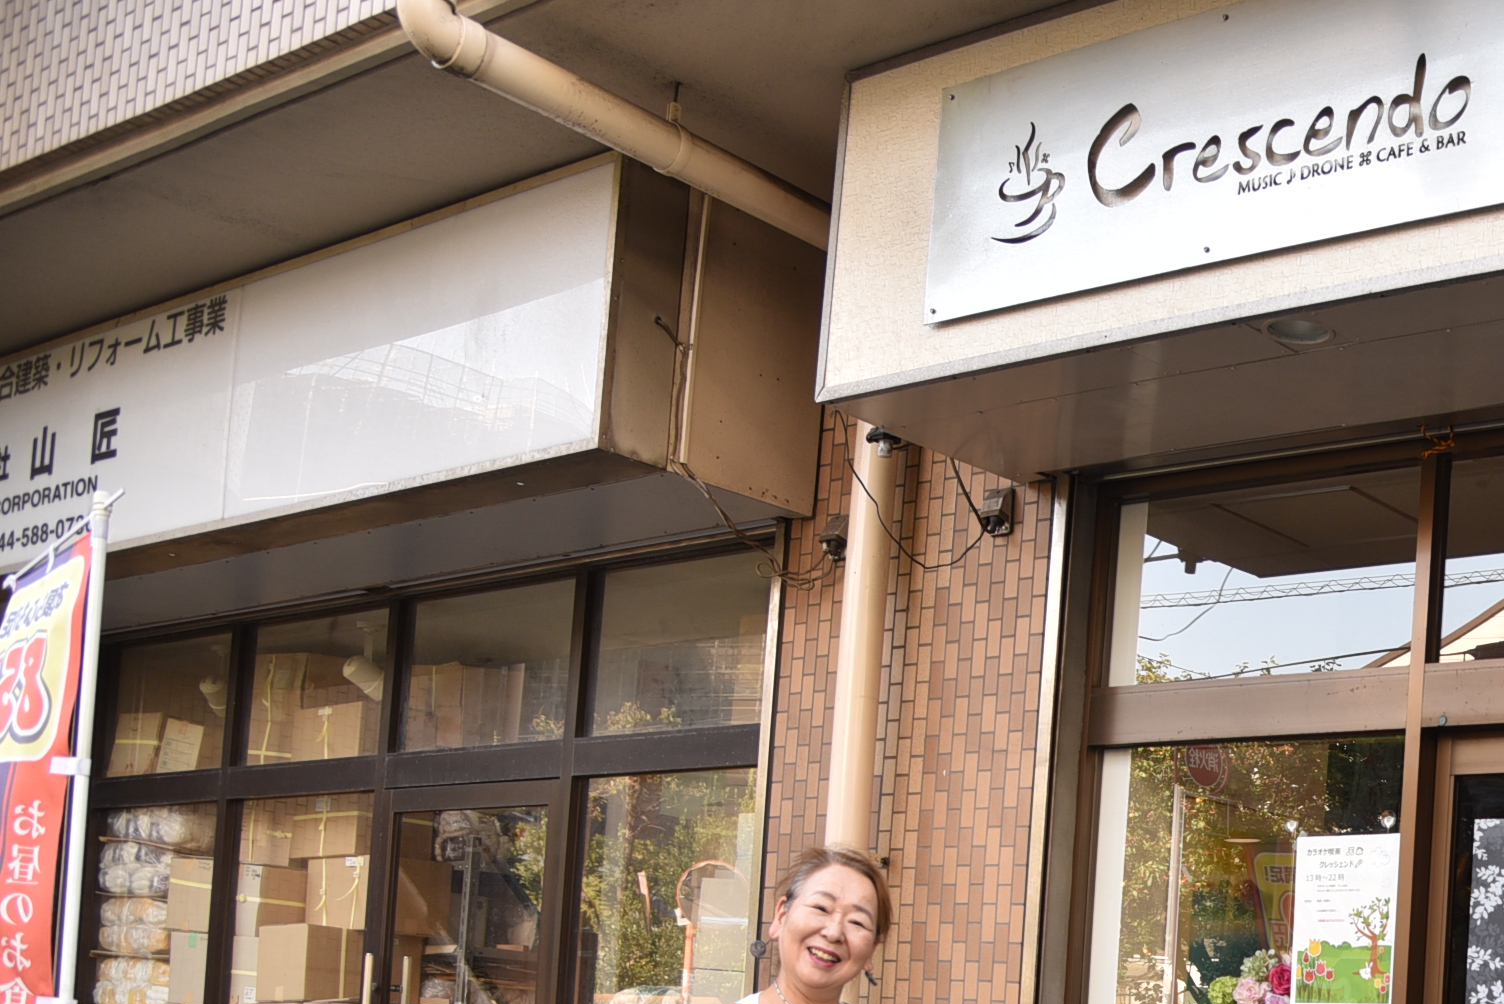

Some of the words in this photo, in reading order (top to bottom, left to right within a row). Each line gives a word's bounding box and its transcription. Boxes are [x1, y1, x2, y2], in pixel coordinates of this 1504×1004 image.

[1087, 52, 1473, 208] Crescendo
[1237, 171, 1283, 196] MUSIC
[1300, 154, 1354, 181] DRONE
[1375, 141, 1415, 164] CAFE
[1418, 138, 1431, 154] &
[1435, 130, 1468, 151] BAR
[0, 475, 98, 516] ORPORATION
